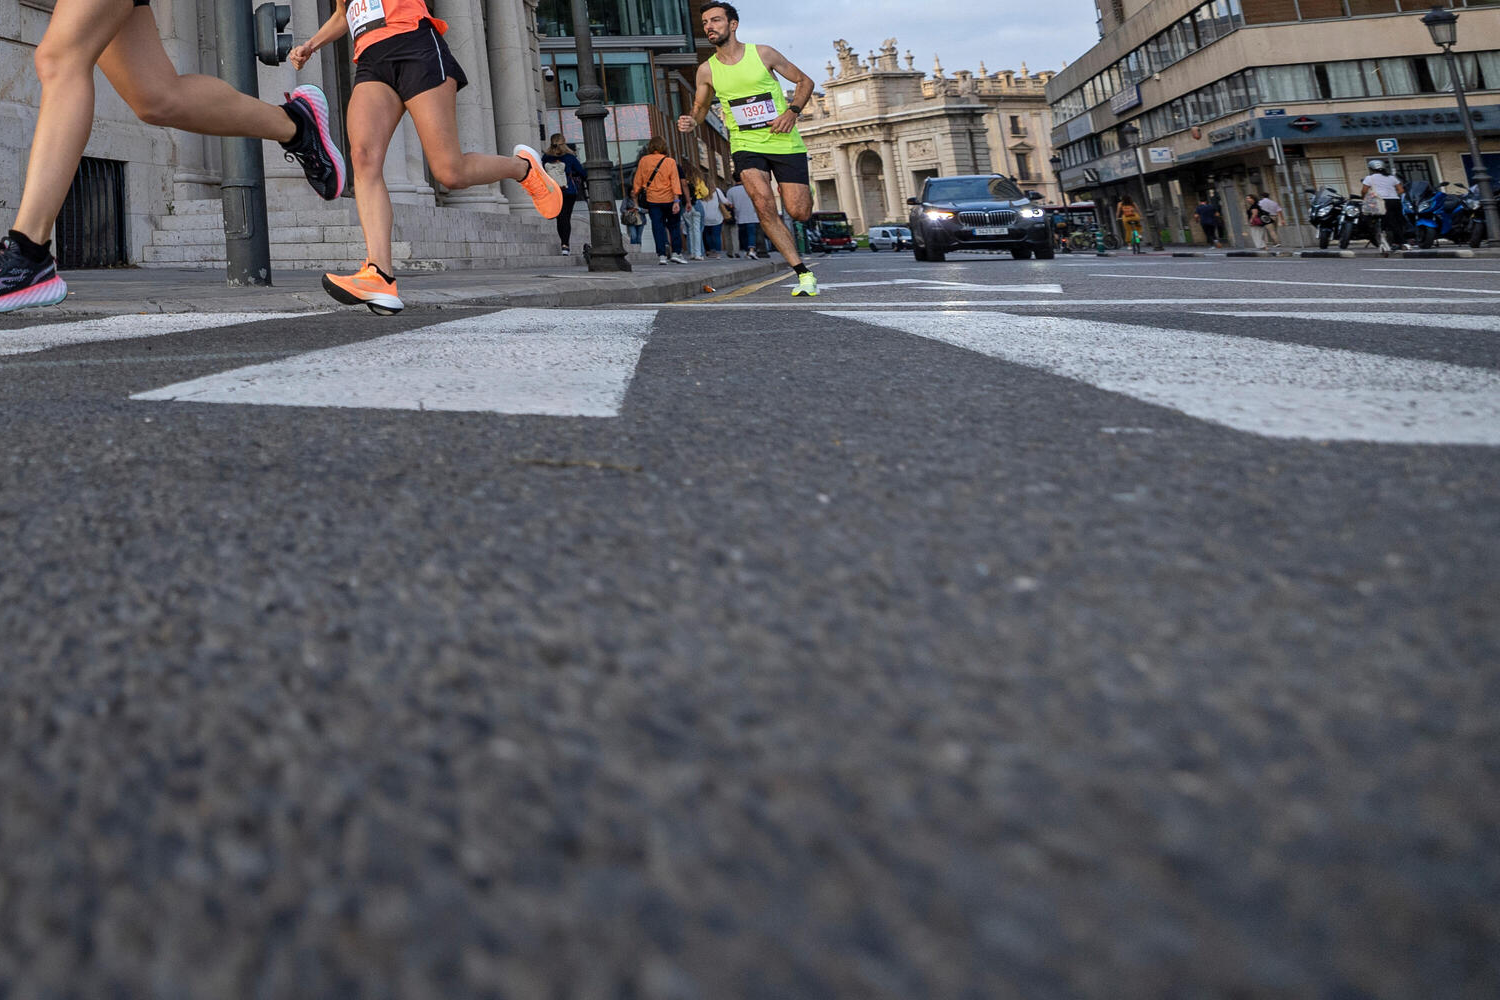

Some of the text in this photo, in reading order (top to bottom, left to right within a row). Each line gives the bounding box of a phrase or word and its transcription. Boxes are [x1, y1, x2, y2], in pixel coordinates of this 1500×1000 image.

[742, 104, 766, 118] 1392
[1338, 110, 1484, 129] Restaurane
[1381, 140, 1394, 152] P
